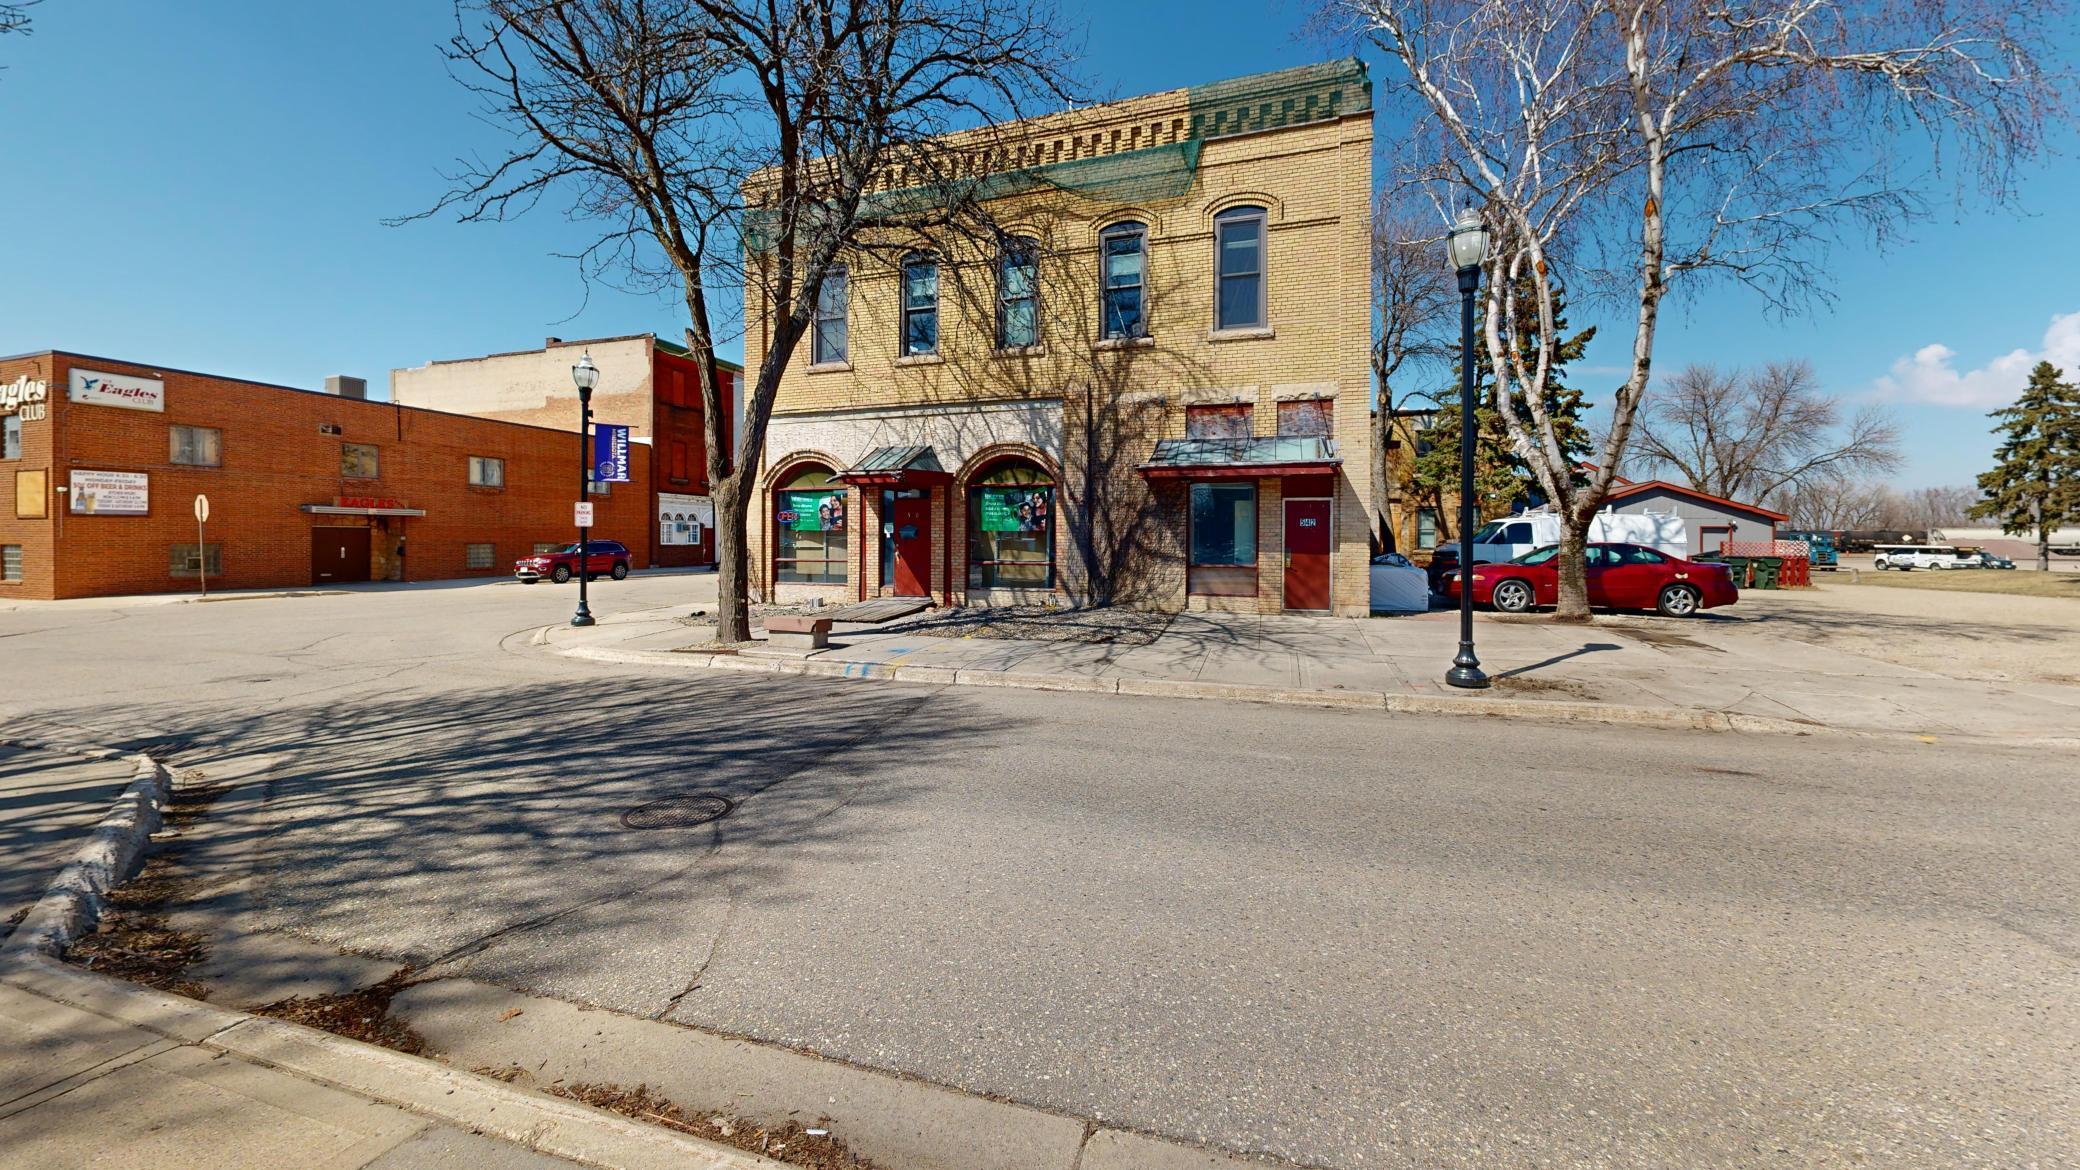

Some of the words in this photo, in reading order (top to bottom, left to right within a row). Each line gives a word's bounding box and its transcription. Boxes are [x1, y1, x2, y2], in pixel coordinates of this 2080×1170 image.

[100, 383, 158, 399] Eagles
[20, 403, 46, 421] CLUB
[617, 428, 627, 480] WILLMAR
[1299, 518, 1316, 527] 542
